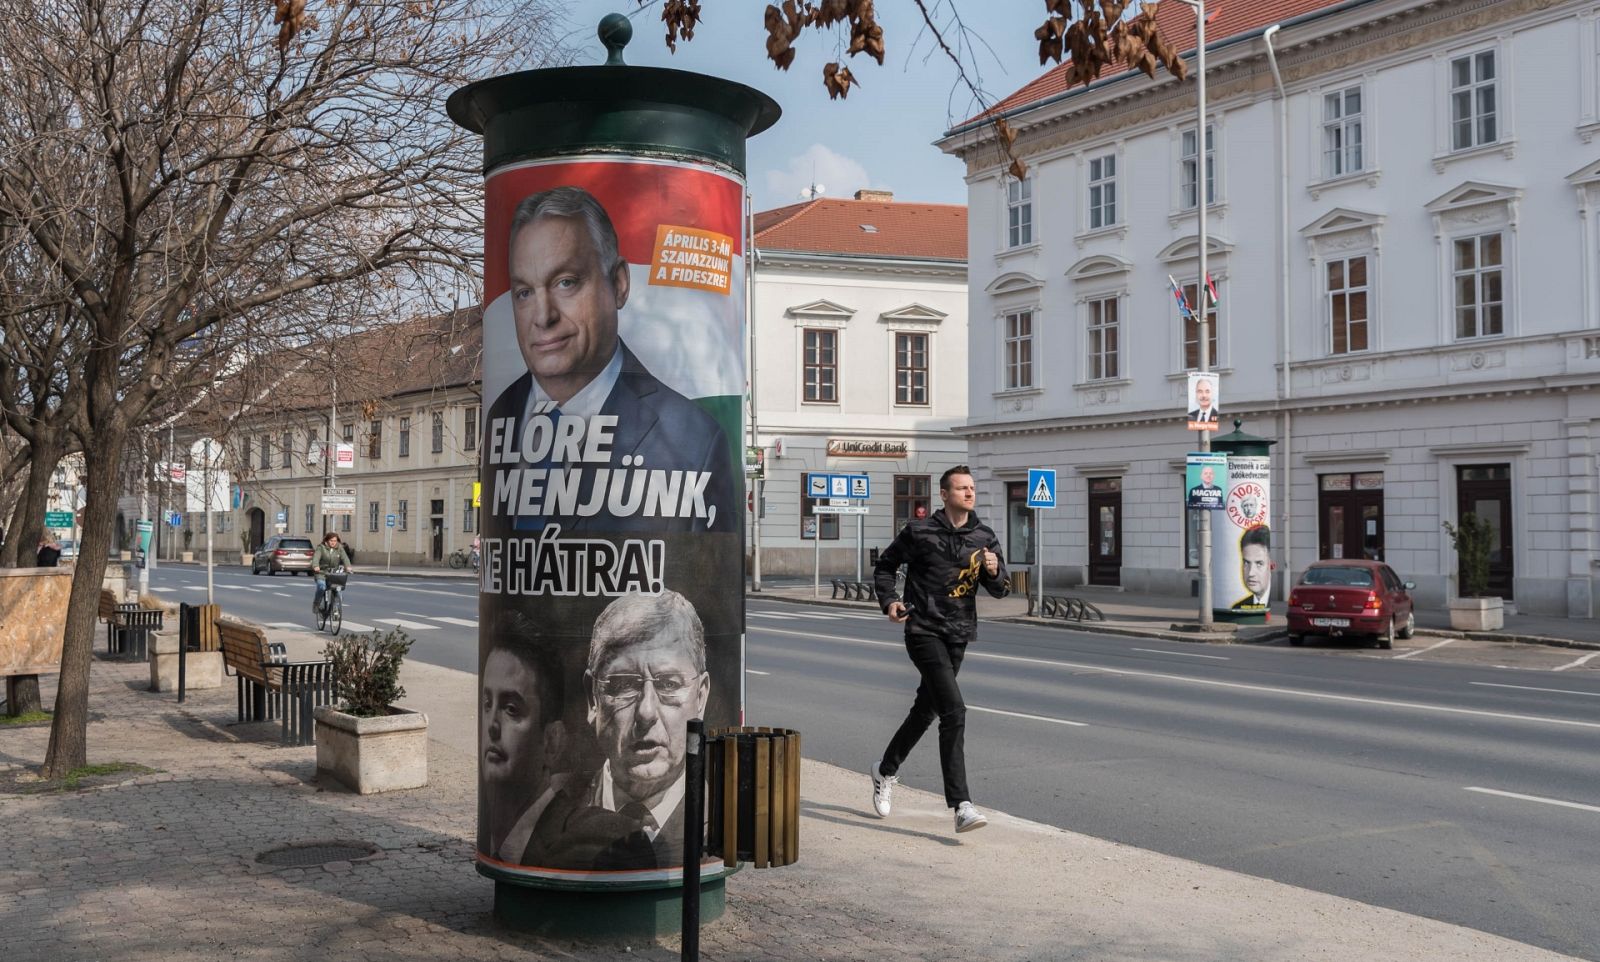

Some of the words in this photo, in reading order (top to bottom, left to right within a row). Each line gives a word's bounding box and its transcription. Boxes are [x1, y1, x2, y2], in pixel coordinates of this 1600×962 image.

[663, 230, 710, 252] ÁPRILIS
[711, 238, 731, 257] 3-ÁN
[660, 250, 728, 272] SZAVAZZUNK
[656, 266, 667, 280] A
[671, 268, 728, 288] FIDESZRE!
[489, 401, 619, 464] ELŐRE
[842, 441, 883, 453] UniCredit
[884, 442, 908, 453] Bank
[492, 454, 716, 529] MENJÜNK,
[1192, 489, 1222, 497] MAGYAR
[1233, 484, 1261, 499] 100%
[507, 523, 665, 596] HÁTRA!
